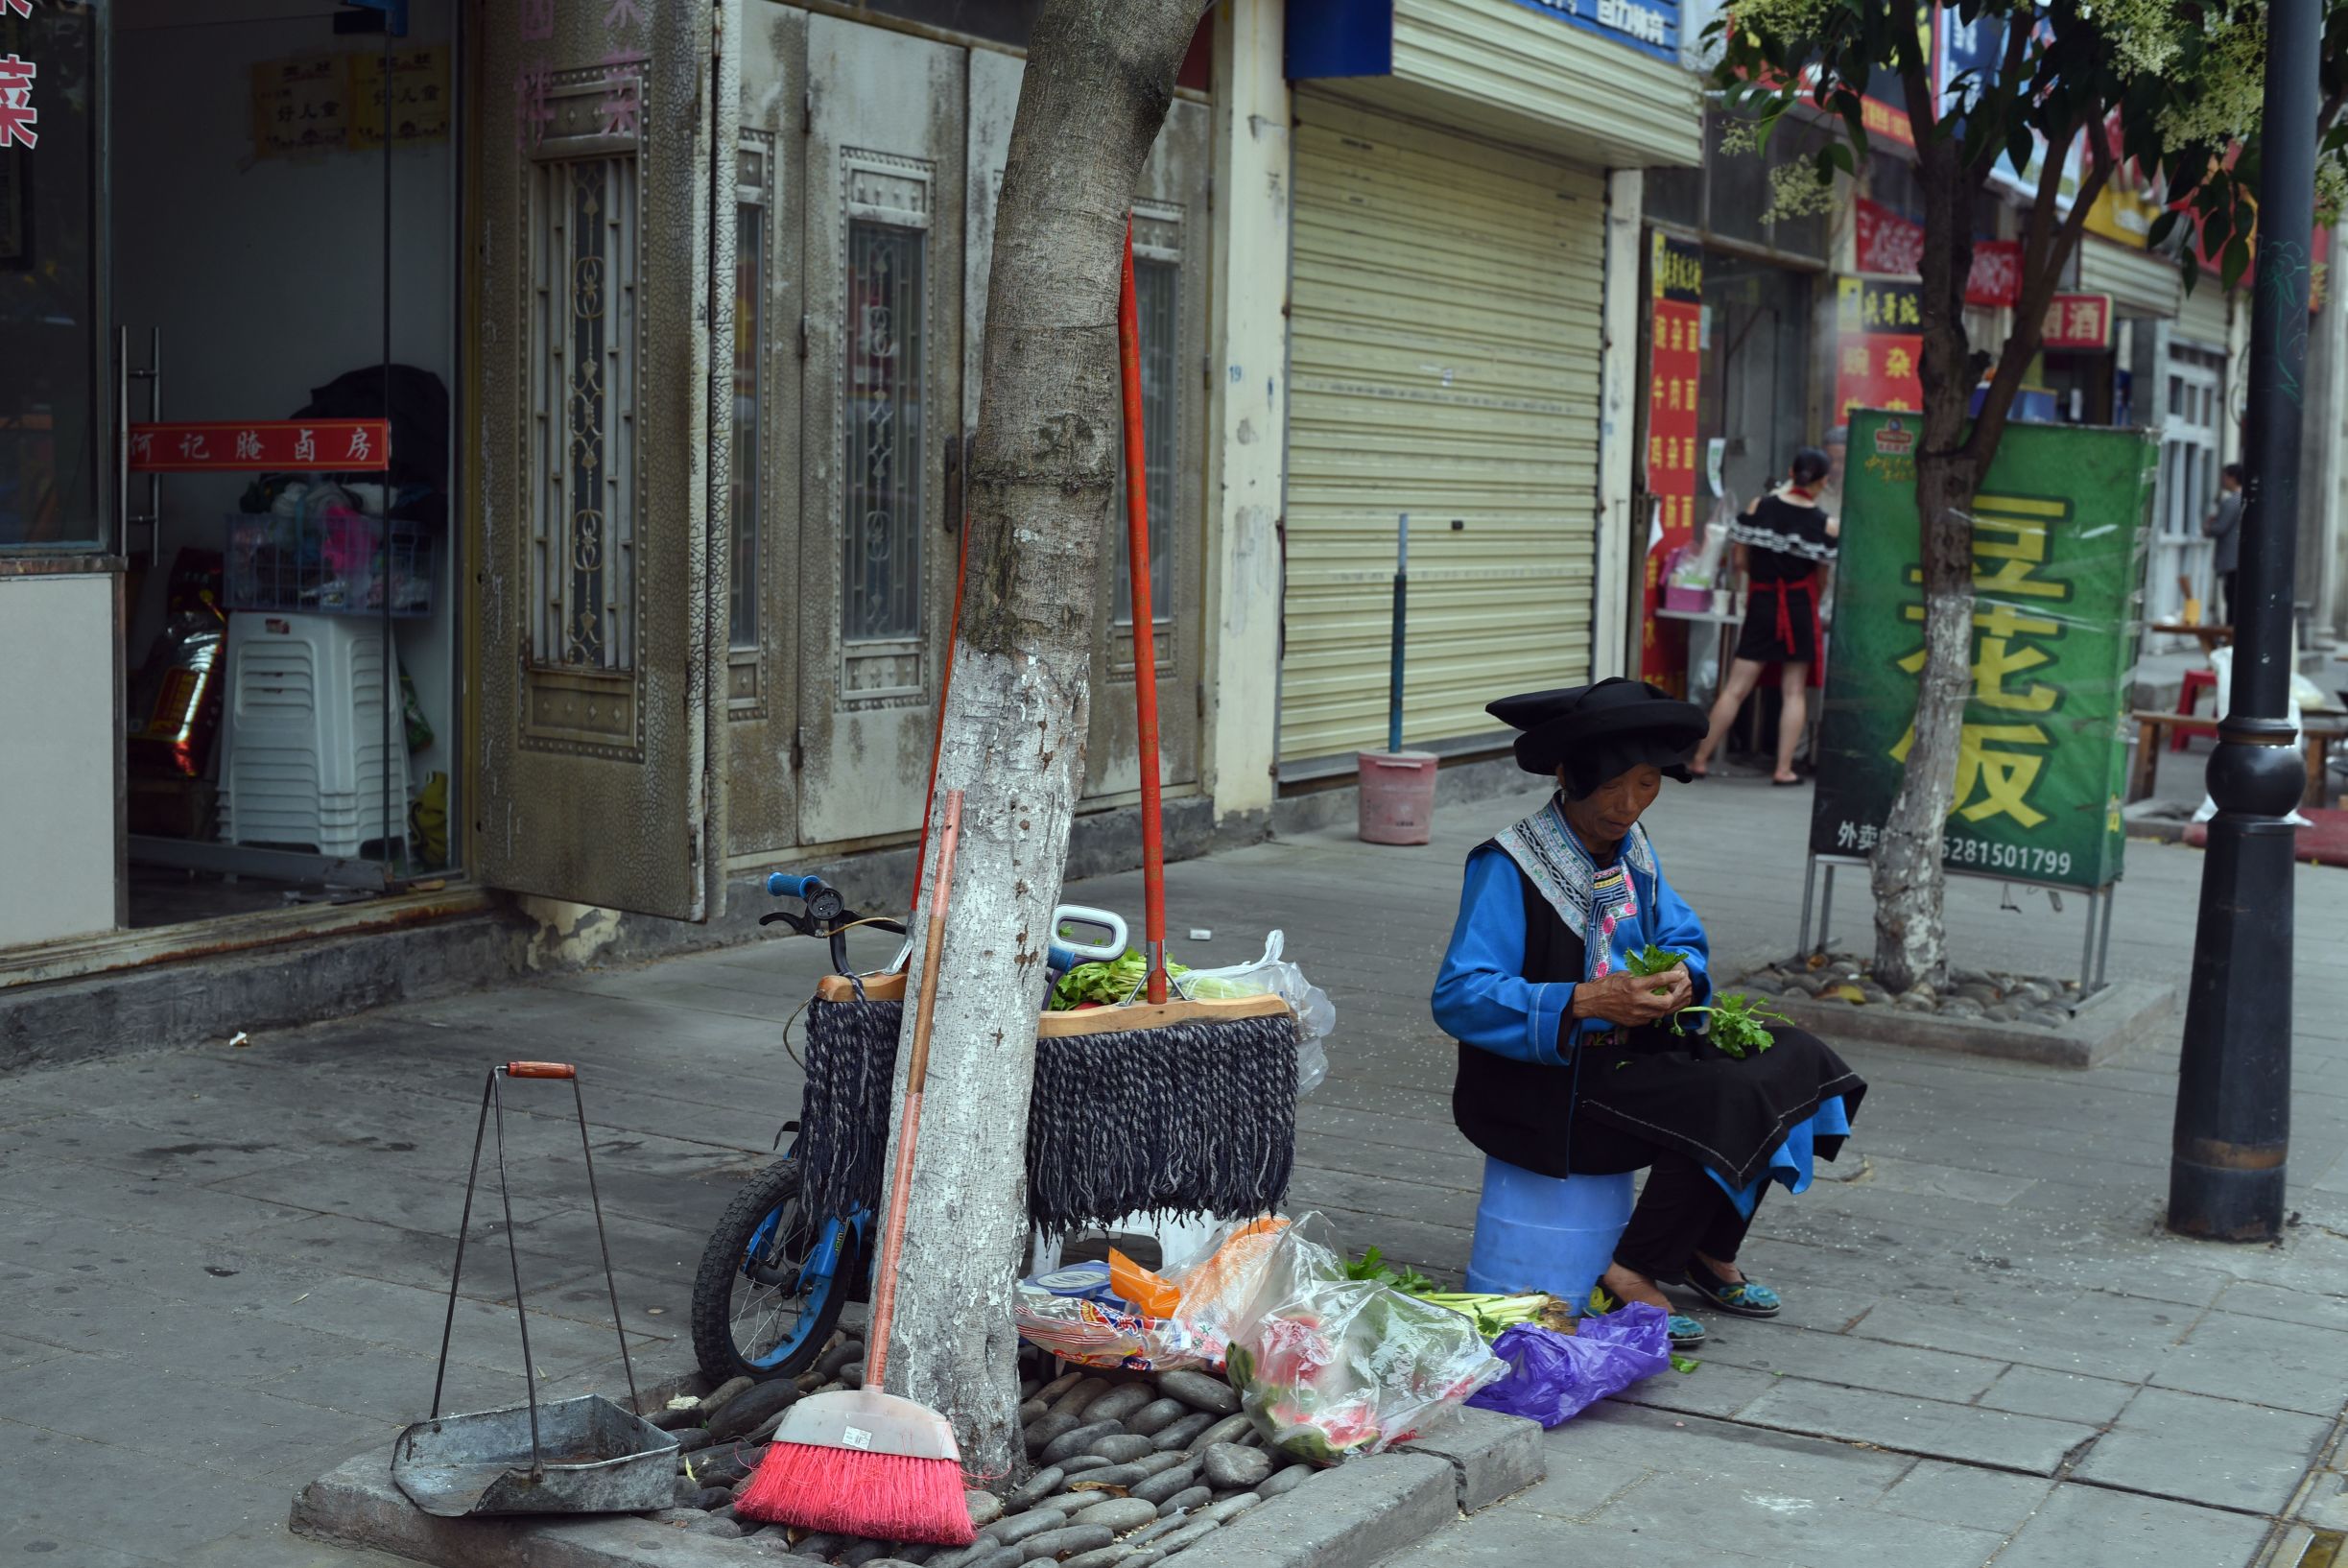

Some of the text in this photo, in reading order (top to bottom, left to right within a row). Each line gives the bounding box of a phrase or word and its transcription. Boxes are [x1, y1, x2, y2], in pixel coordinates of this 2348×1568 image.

[130, 426, 372, 462] 何记腌卤房
